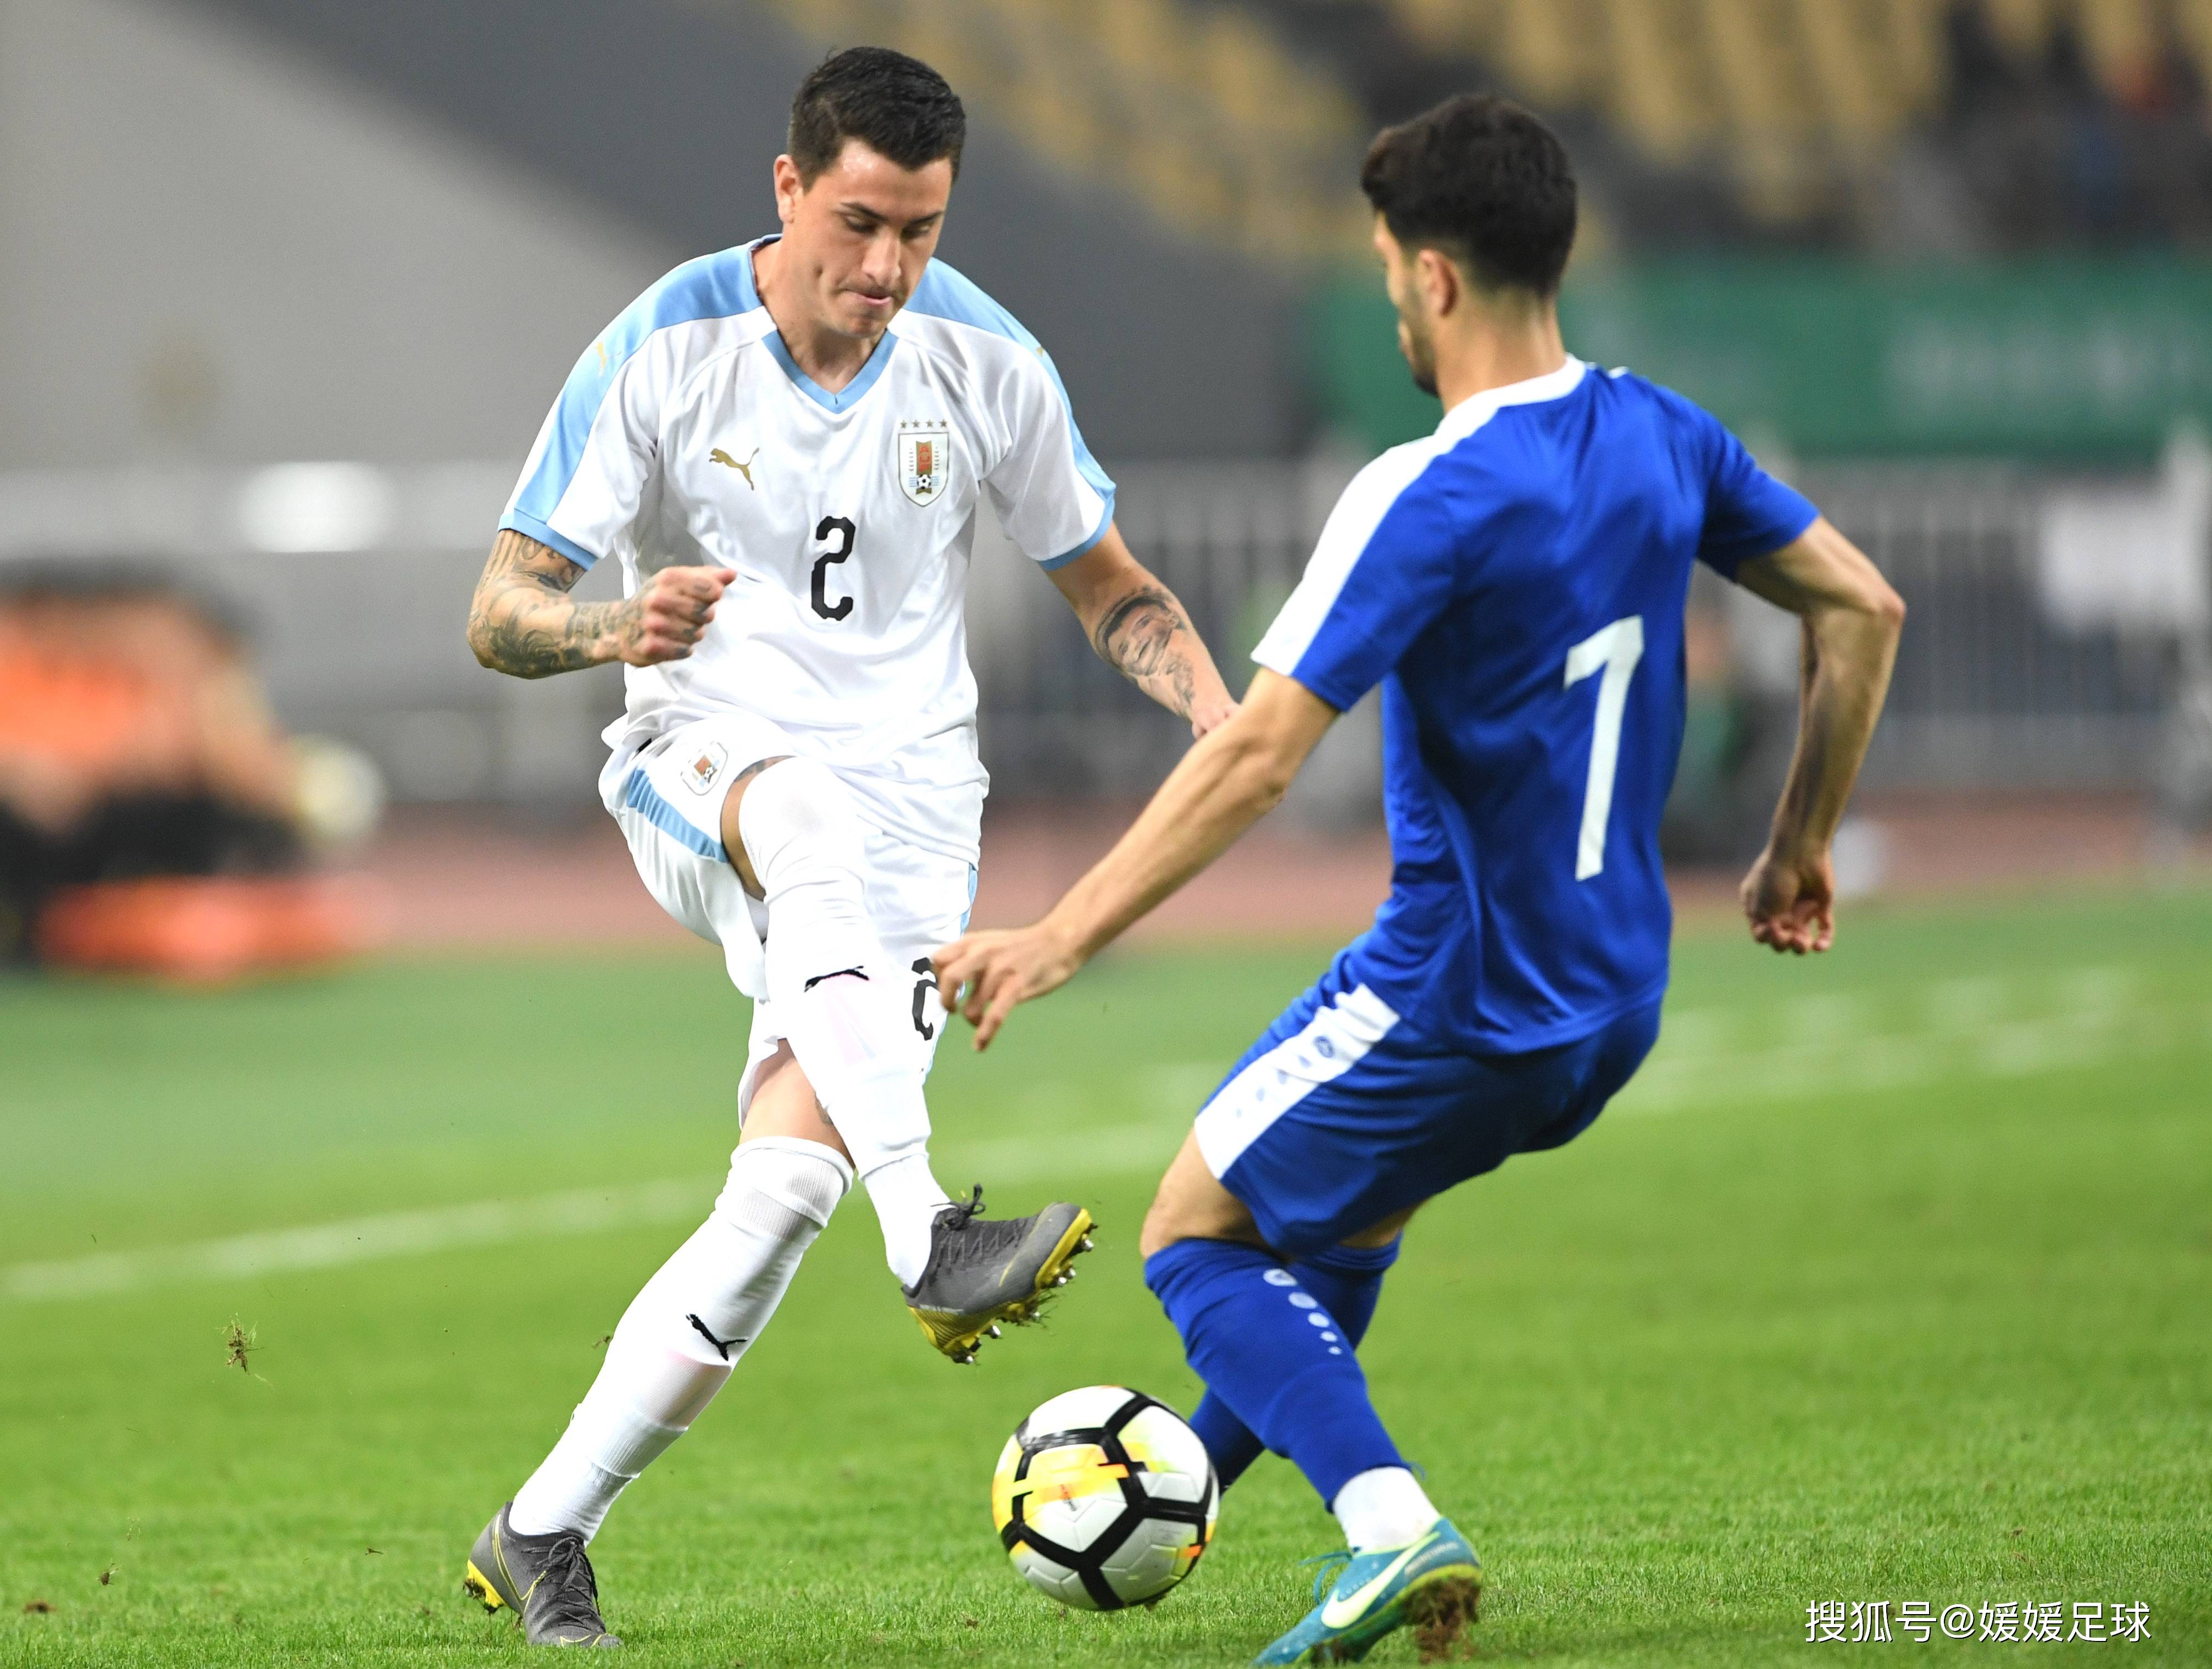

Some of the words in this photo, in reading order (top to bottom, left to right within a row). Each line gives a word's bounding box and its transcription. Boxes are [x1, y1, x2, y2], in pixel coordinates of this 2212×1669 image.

[811, 515, 856, 622] 2
[1563, 614, 1644, 881] 7
[912, 957, 941, 1041] 2
